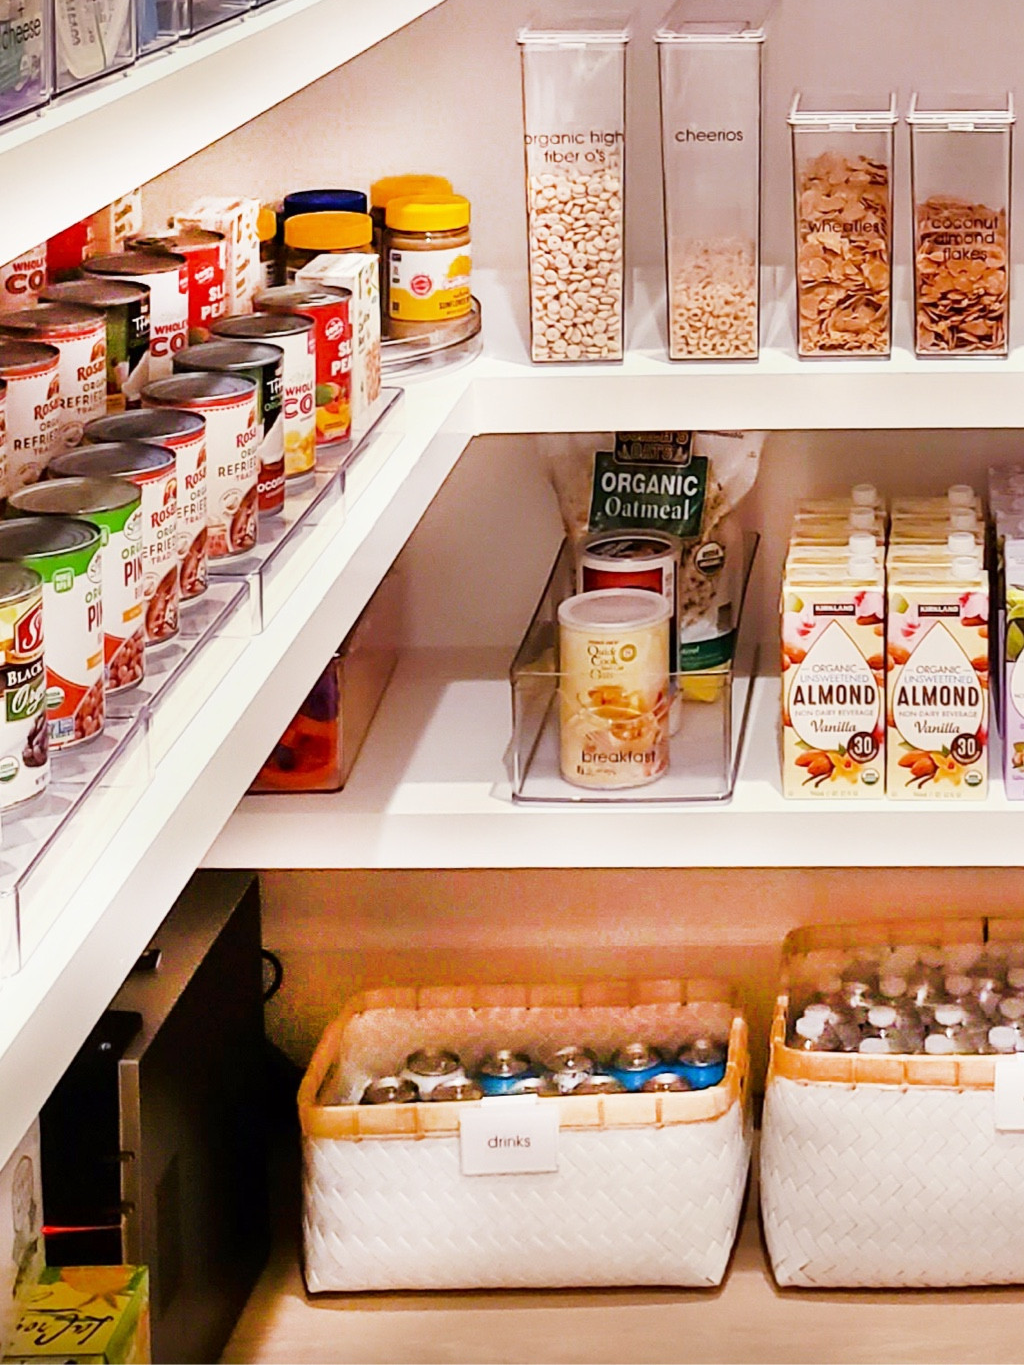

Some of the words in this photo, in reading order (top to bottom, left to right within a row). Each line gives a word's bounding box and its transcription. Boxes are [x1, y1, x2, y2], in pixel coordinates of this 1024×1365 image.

[1, 18, 42, 50] cheese
[523, 131, 586, 148] organic
[589, 130, 625, 149] high
[675, 128, 744, 143] cheerios
[543, 148, 581, 163] fiber
[584, 149, 606, 163] o's
[808, 219, 880, 234] wheaties
[931, 215, 999, 230] coconut
[933, 231, 995, 245] almond
[942, 246, 989, 261] flakes
[600, 471, 699, 497] ORGANIC
[604, 495, 690, 521] Oatmeal
[811, 664, 857, 673] ORGANIC
[915, 665, 961, 674] ORGANIC
[792, 684, 876, 706] ALMOND
[896, 686, 980, 707] ALMOND
[810, 718, 857, 733] Vanilla
[914, 719, 961, 734] Vanilla
[853, 736, 873, 755] 30
[957, 737, 977, 756] 30
[581, 750, 656, 764] breakfast
[487, 1133, 531, 1150] drinks
